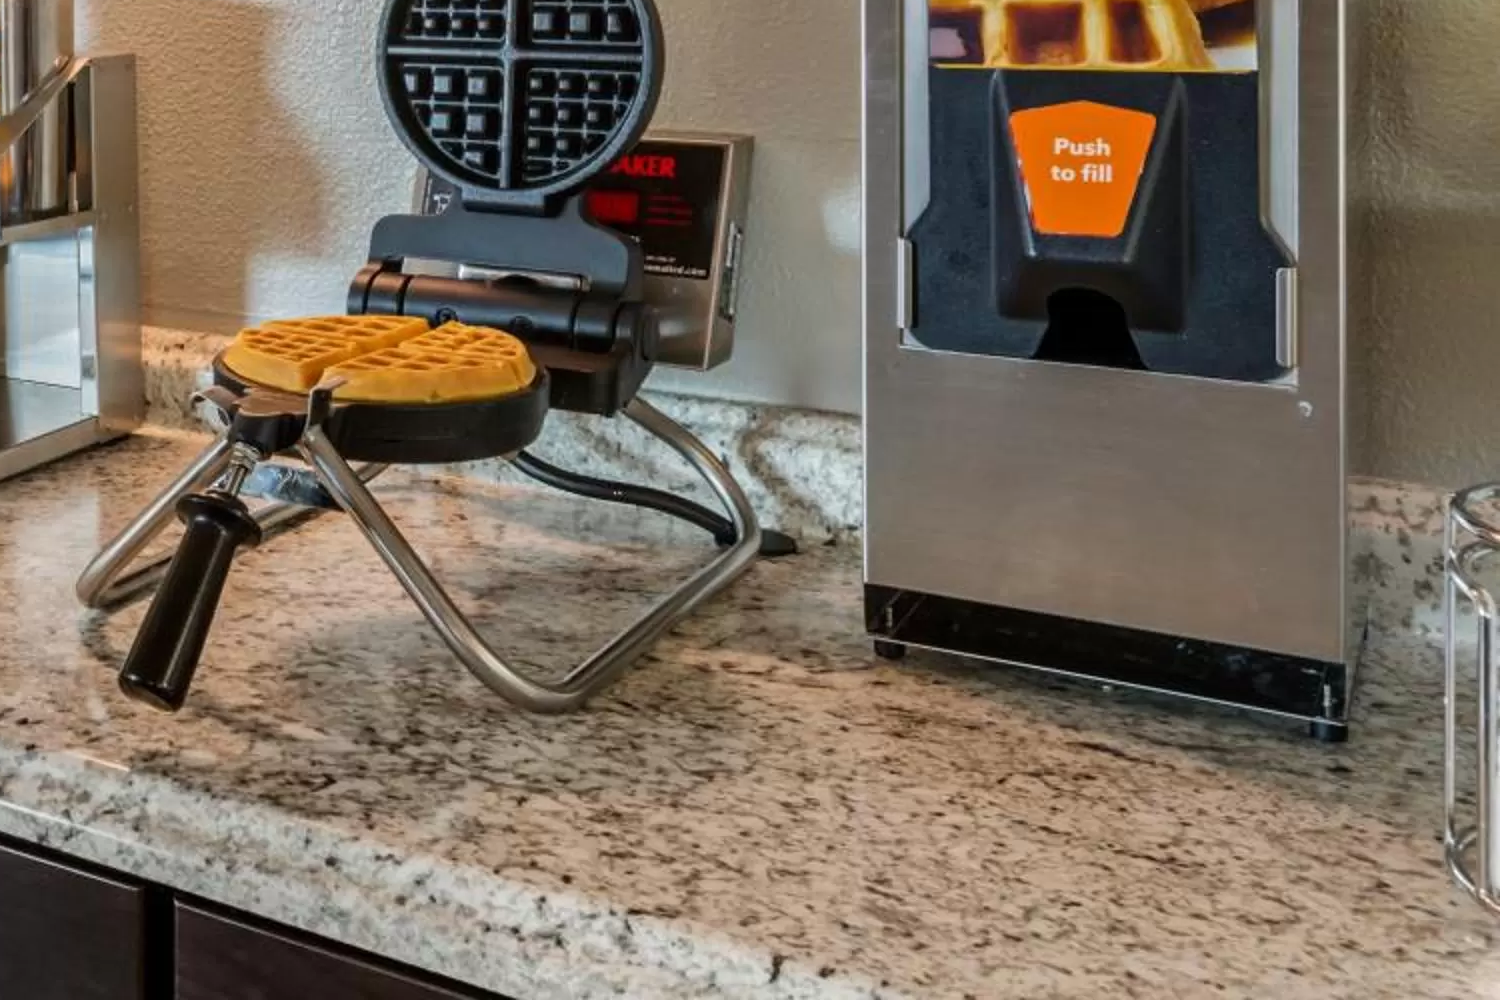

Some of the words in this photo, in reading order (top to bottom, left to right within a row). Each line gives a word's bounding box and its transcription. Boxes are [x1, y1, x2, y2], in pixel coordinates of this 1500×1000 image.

[1053, 137, 1112, 157] Push
[610, 154, 677, 179] AKER
[1051, 165, 1076, 182] to
[1081, 164, 1113, 183] fill
